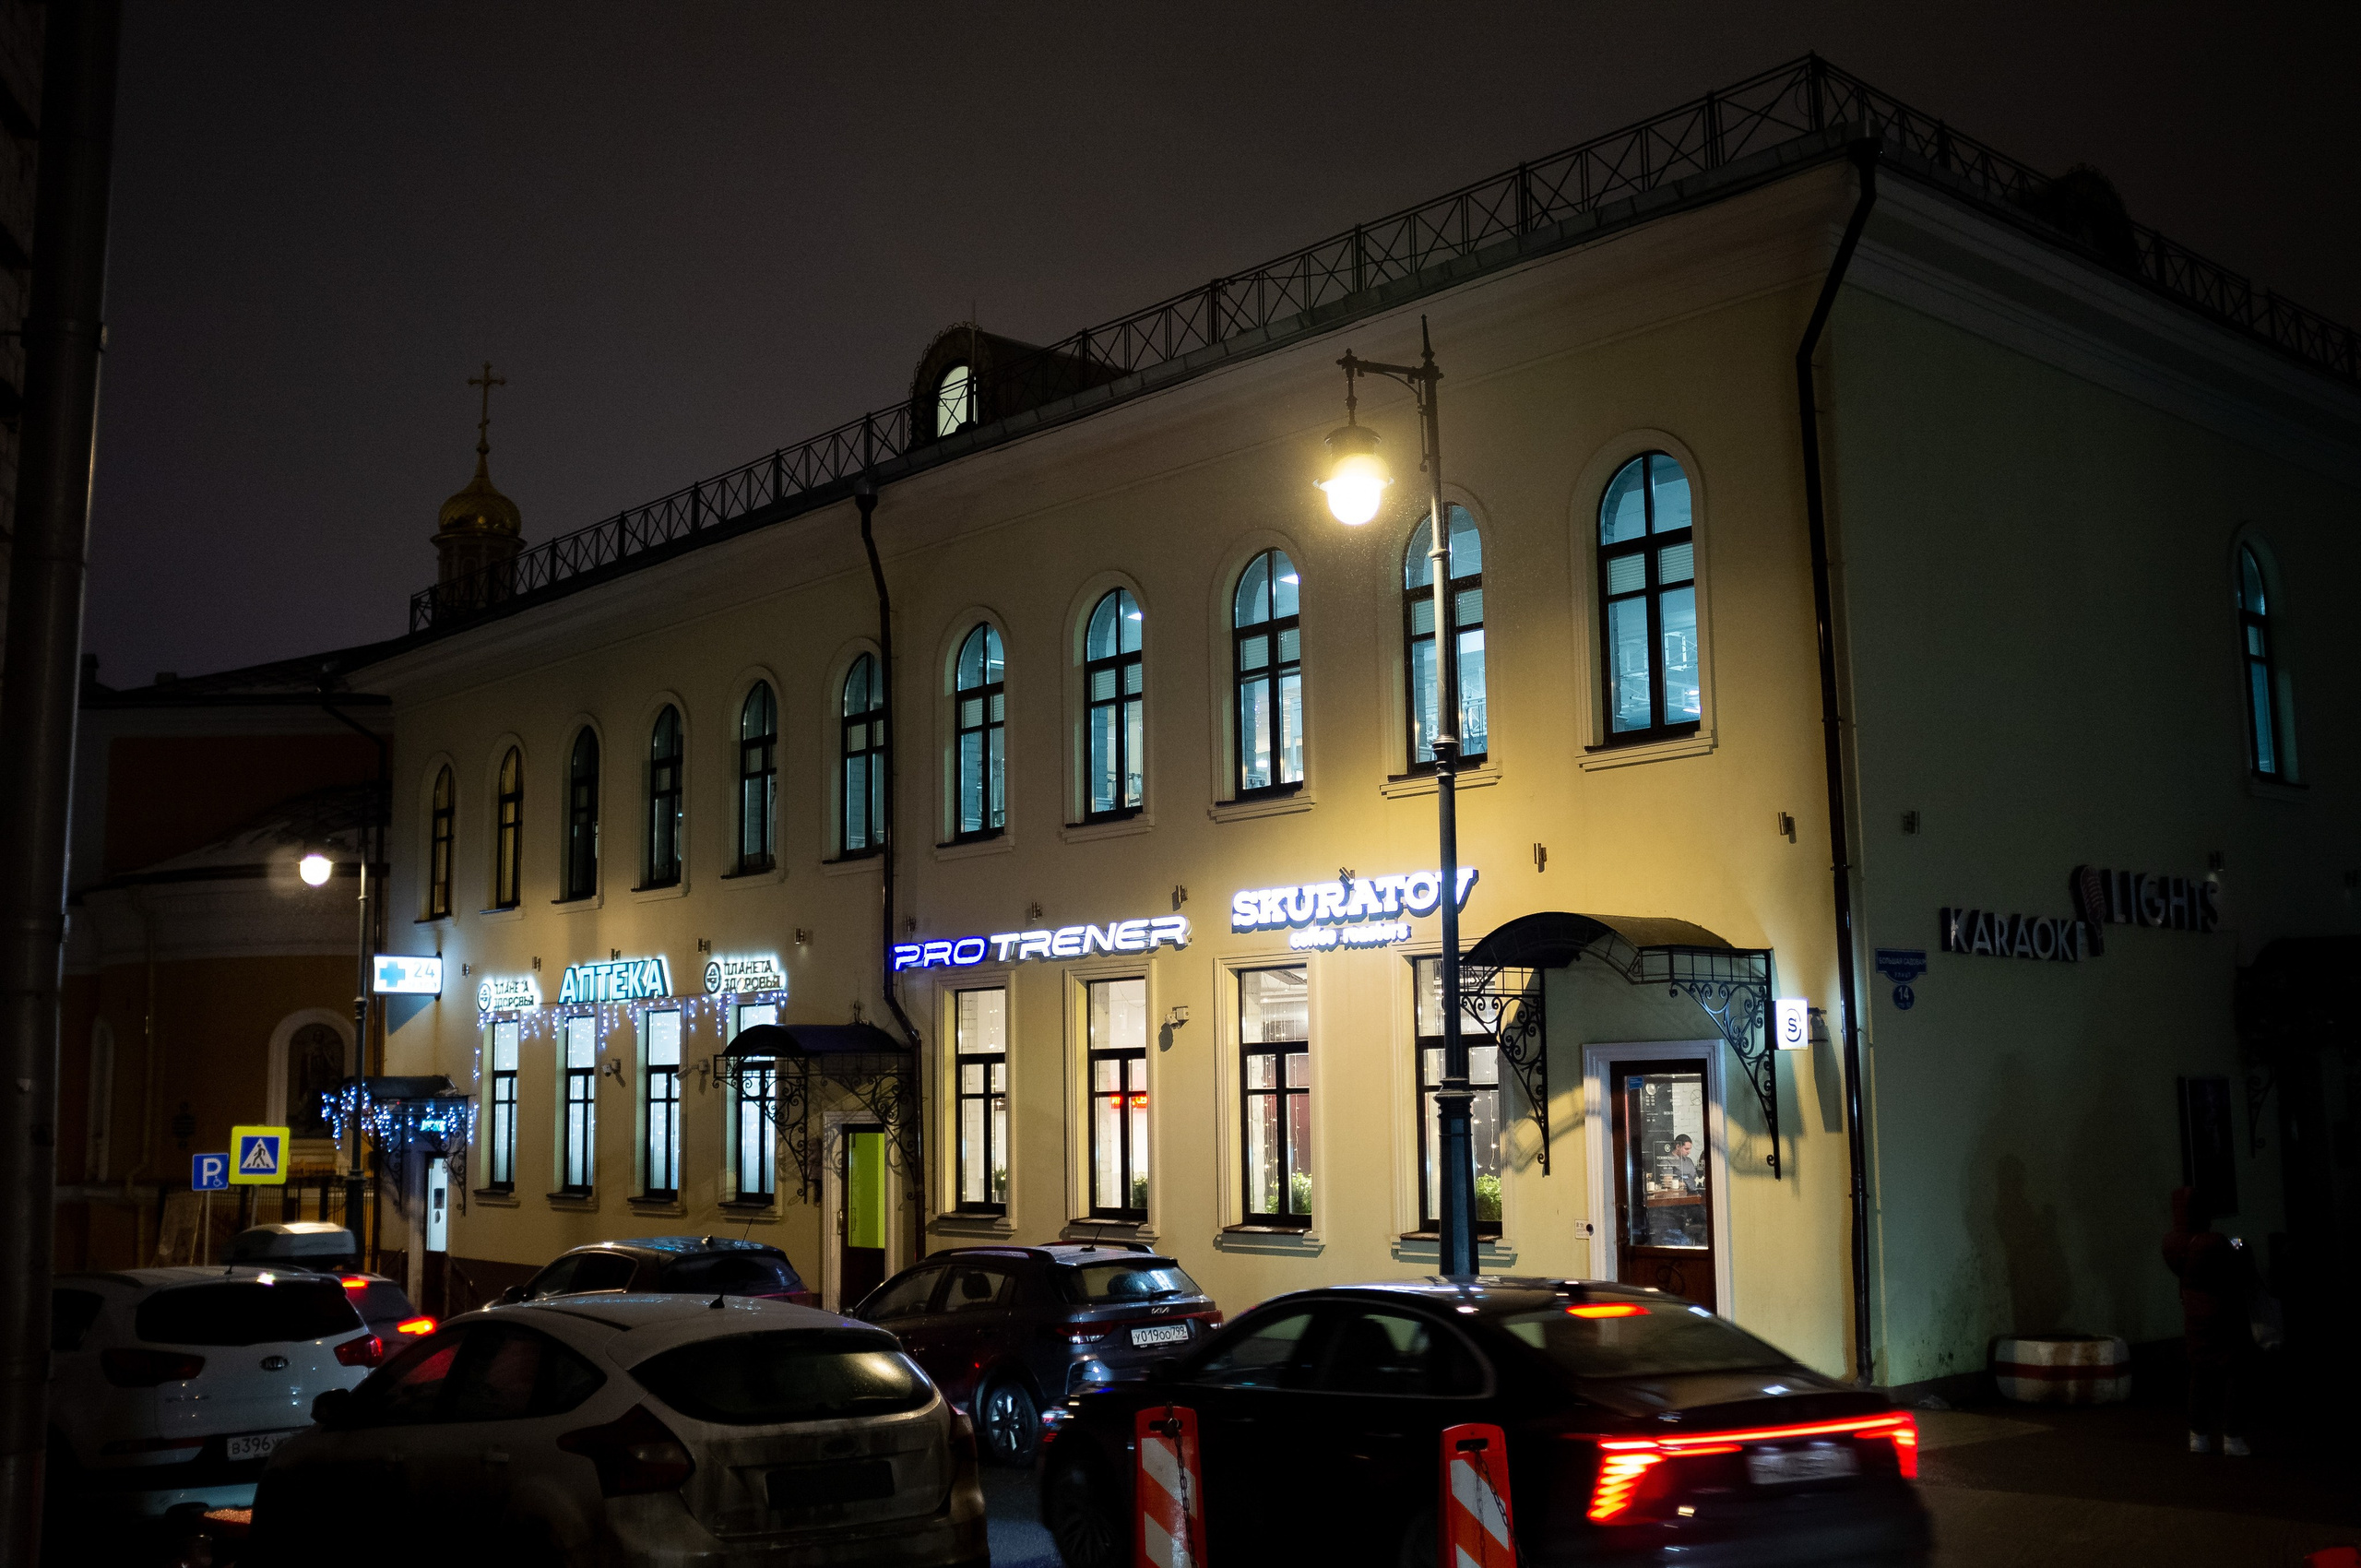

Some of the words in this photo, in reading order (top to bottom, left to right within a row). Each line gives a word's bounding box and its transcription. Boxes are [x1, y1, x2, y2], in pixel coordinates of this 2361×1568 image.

[1232, 868, 1476, 928] SKURATOV
[2110, 870, 2220, 932] LIGHTS
[894, 936, 986, 970] PRO
[990, 915, 1189, 962] TRENER
[413, 961, 435, 979] 24
[724, 959, 773, 976] ПЛАНЕТА
[557, 958, 668, 1004] АПТЕКА
[724, 975, 781, 992] ЗДОРОВЬЯ
[1898, 986, 1910, 1001] 14
[1786, 1016, 1798, 1033] S
[202, 1158, 222, 1187] P
[265, 1358, 285, 1369] KIA
